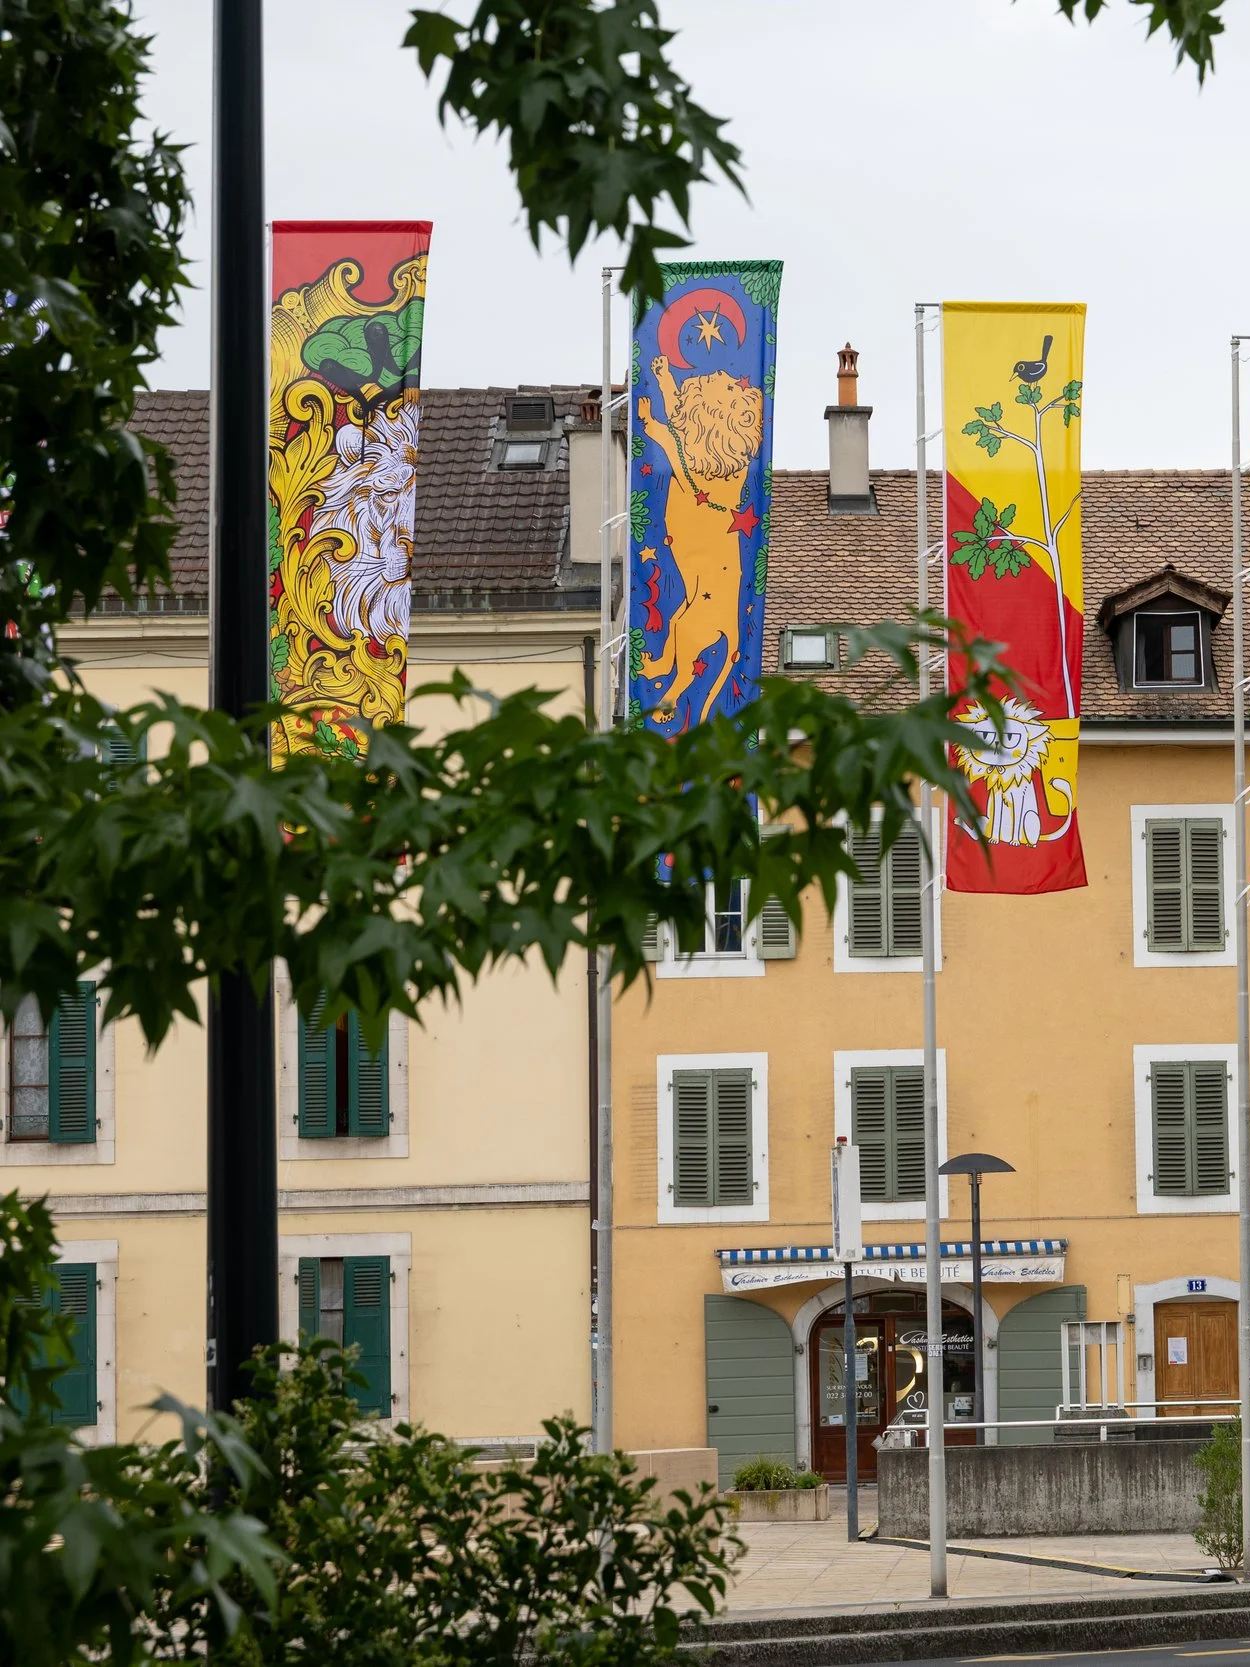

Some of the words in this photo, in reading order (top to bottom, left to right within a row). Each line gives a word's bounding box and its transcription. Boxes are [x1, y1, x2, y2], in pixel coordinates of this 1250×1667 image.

[825, 1268, 884, 1277] INSITUT
[910, 1264, 960, 1278] BEUTÉ
[1020, 1267, 1056, 1276] Esthetics
[1192, 1280, 1202, 1290] 13
[941, 1333, 973, 1343] Esthetics
